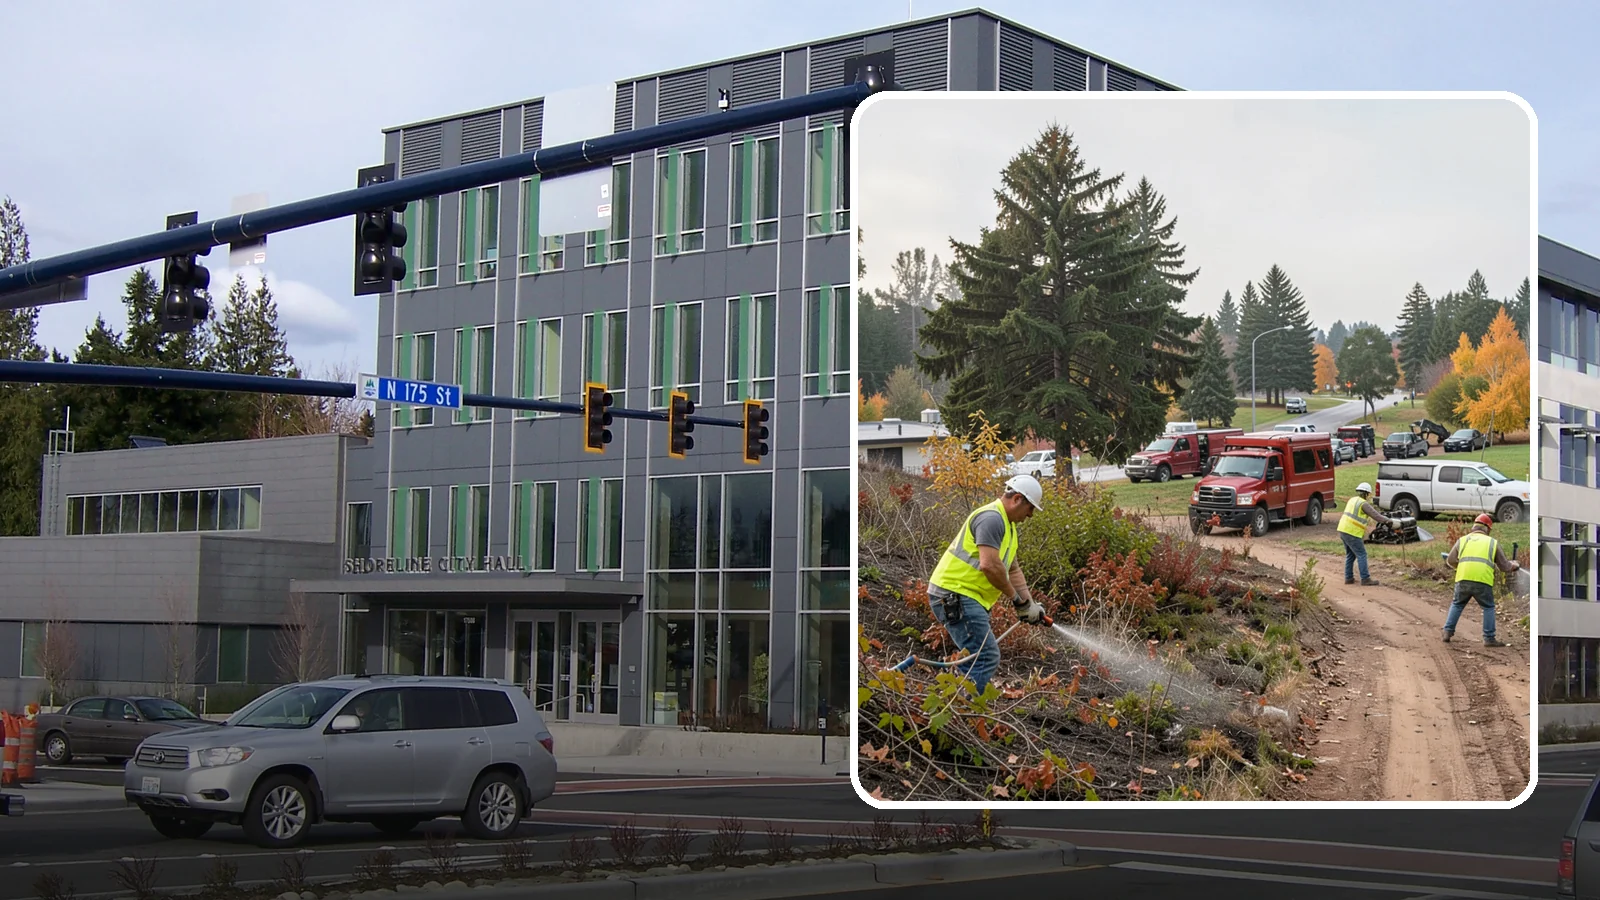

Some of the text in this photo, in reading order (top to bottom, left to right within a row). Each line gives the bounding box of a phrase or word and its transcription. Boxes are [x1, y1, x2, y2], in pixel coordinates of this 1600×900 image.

[387, 380, 451, 406] N 175 St
[344, 555, 525, 574] SHORELINE CITY HALL
